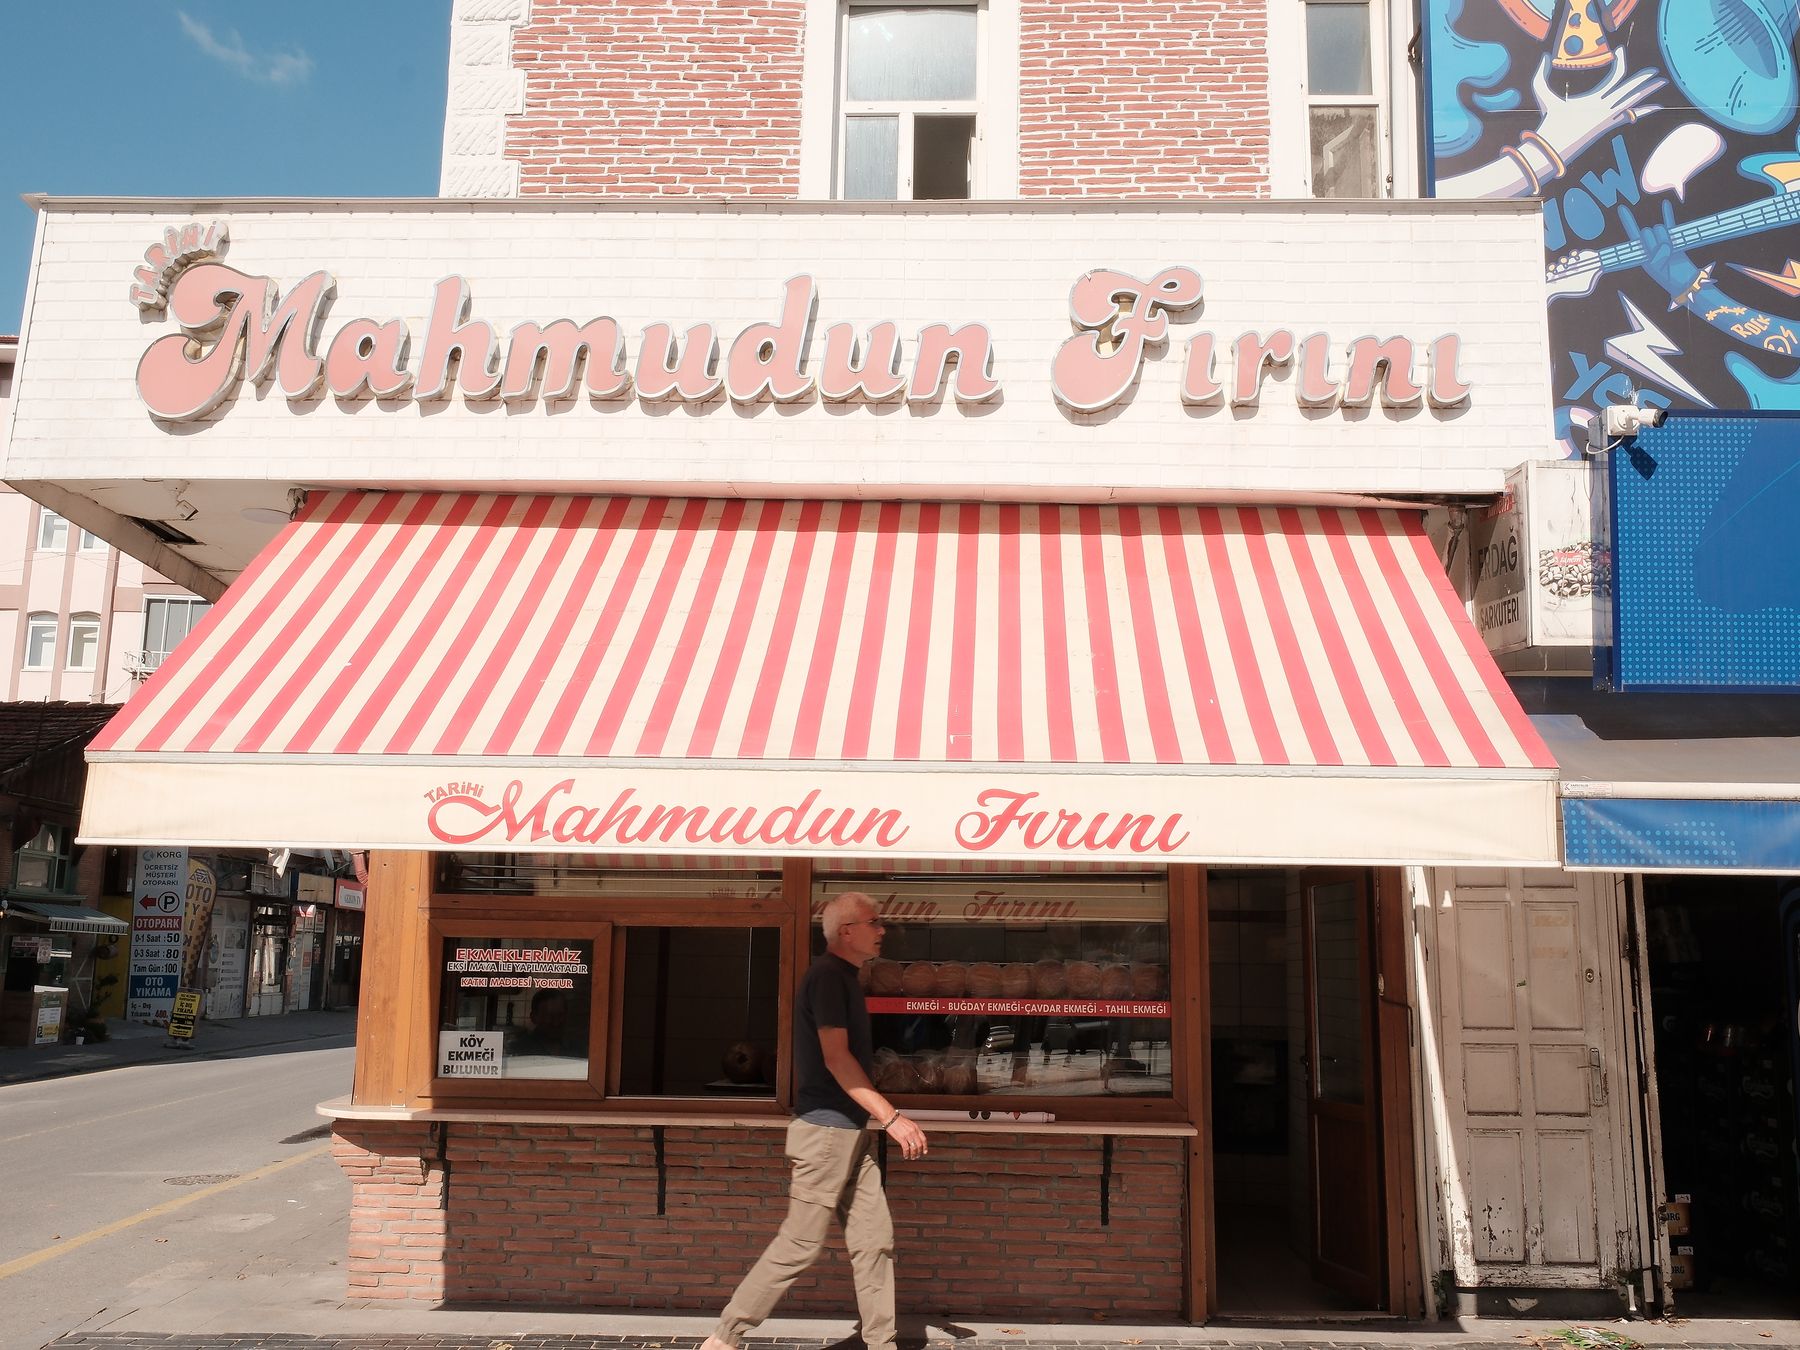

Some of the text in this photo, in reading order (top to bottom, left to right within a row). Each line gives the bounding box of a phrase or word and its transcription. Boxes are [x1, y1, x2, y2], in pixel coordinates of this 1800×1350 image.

[1731, 314, 1770, 338] ROCK
[136, 263, 1003, 422] Mahmudun
[427, 778, 1191, 853] Mahmudun Fırını
[186, 884, 212, 903] OTO
[136, 918, 180, 928] OTOPARK
[146, 934, 160, 943] Saat
[146, 949, 160, 957] Saat
[456, 947, 582, 963] EKMEKLERİMİZ
[133, 964, 146, 972] Tam
[447, 961, 588, 974] EKŞİ MAYA İLE YAPILMAKTADIR
[145, 977, 163, 986] OTO
[461, 976, 573, 988] KATKI MADDESİ YOKTUR
[136, 988, 171, 997] YIKAMA
[906, 999, 939, 1010] EKMEĞİ
[948, 1000, 985, 1011] BUĞDAY
[1063, 1002, 1097, 1013] EKMEĞİ
[1105, 1004, 1130, 1014] TAHIL
[1133, 1003, 1166, 1014] EKMEĞİ
[460, 1034, 484, 1047] KÖY
[448, 1048, 494, 1061] EKMEĞİ
[443, 1064, 499, 1075] BULUNUR
